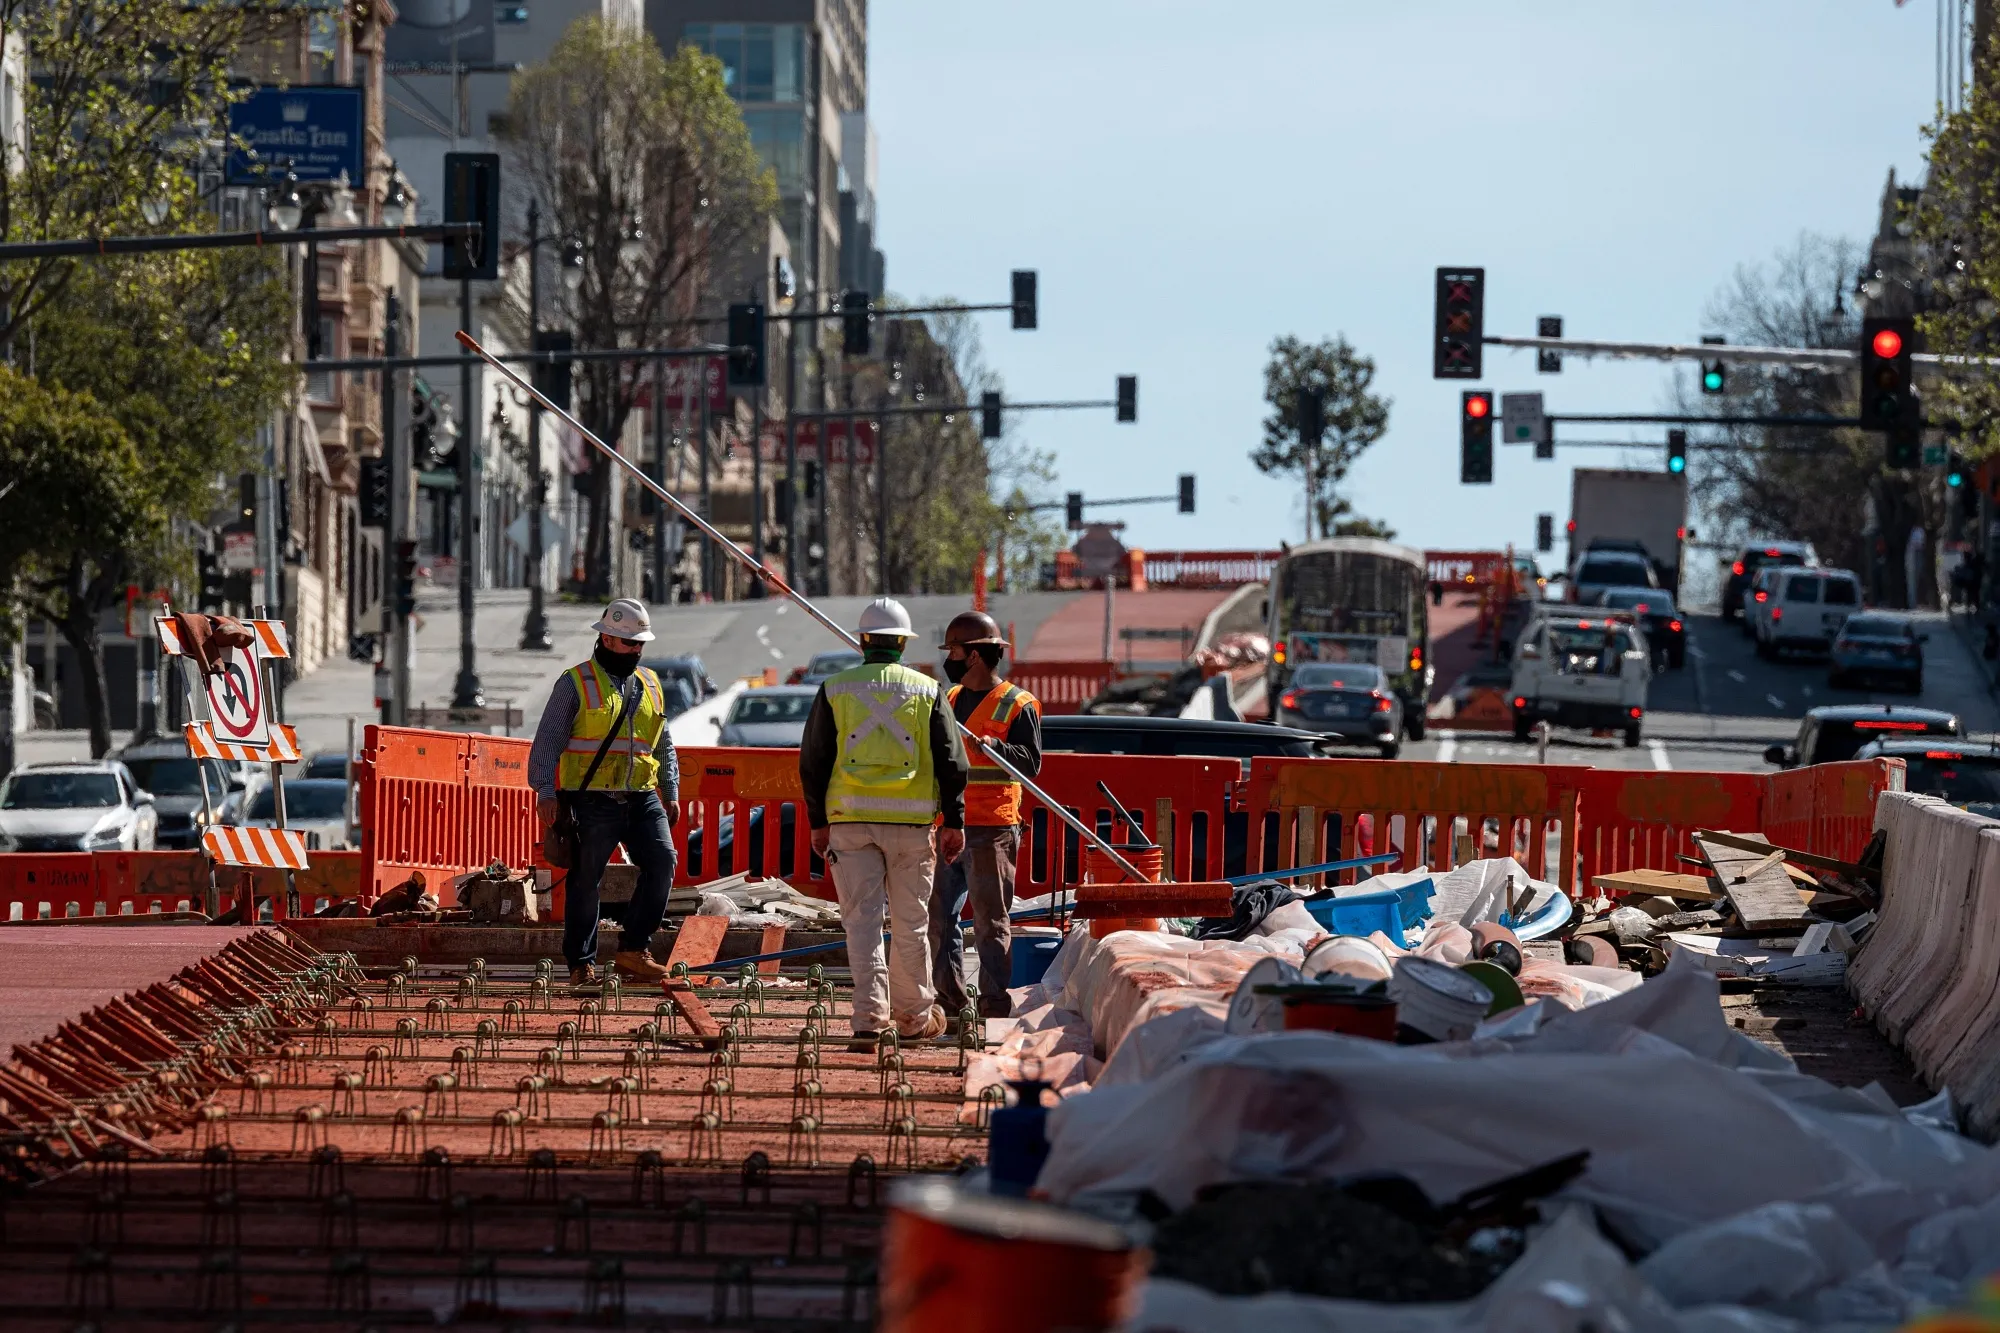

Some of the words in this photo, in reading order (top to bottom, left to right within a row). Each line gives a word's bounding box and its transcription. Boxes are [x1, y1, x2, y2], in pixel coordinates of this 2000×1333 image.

[239, 124, 307, 146] Castle
[308, 125, 348, 148] Inn
[705, 767, 735, 776] WALSH
